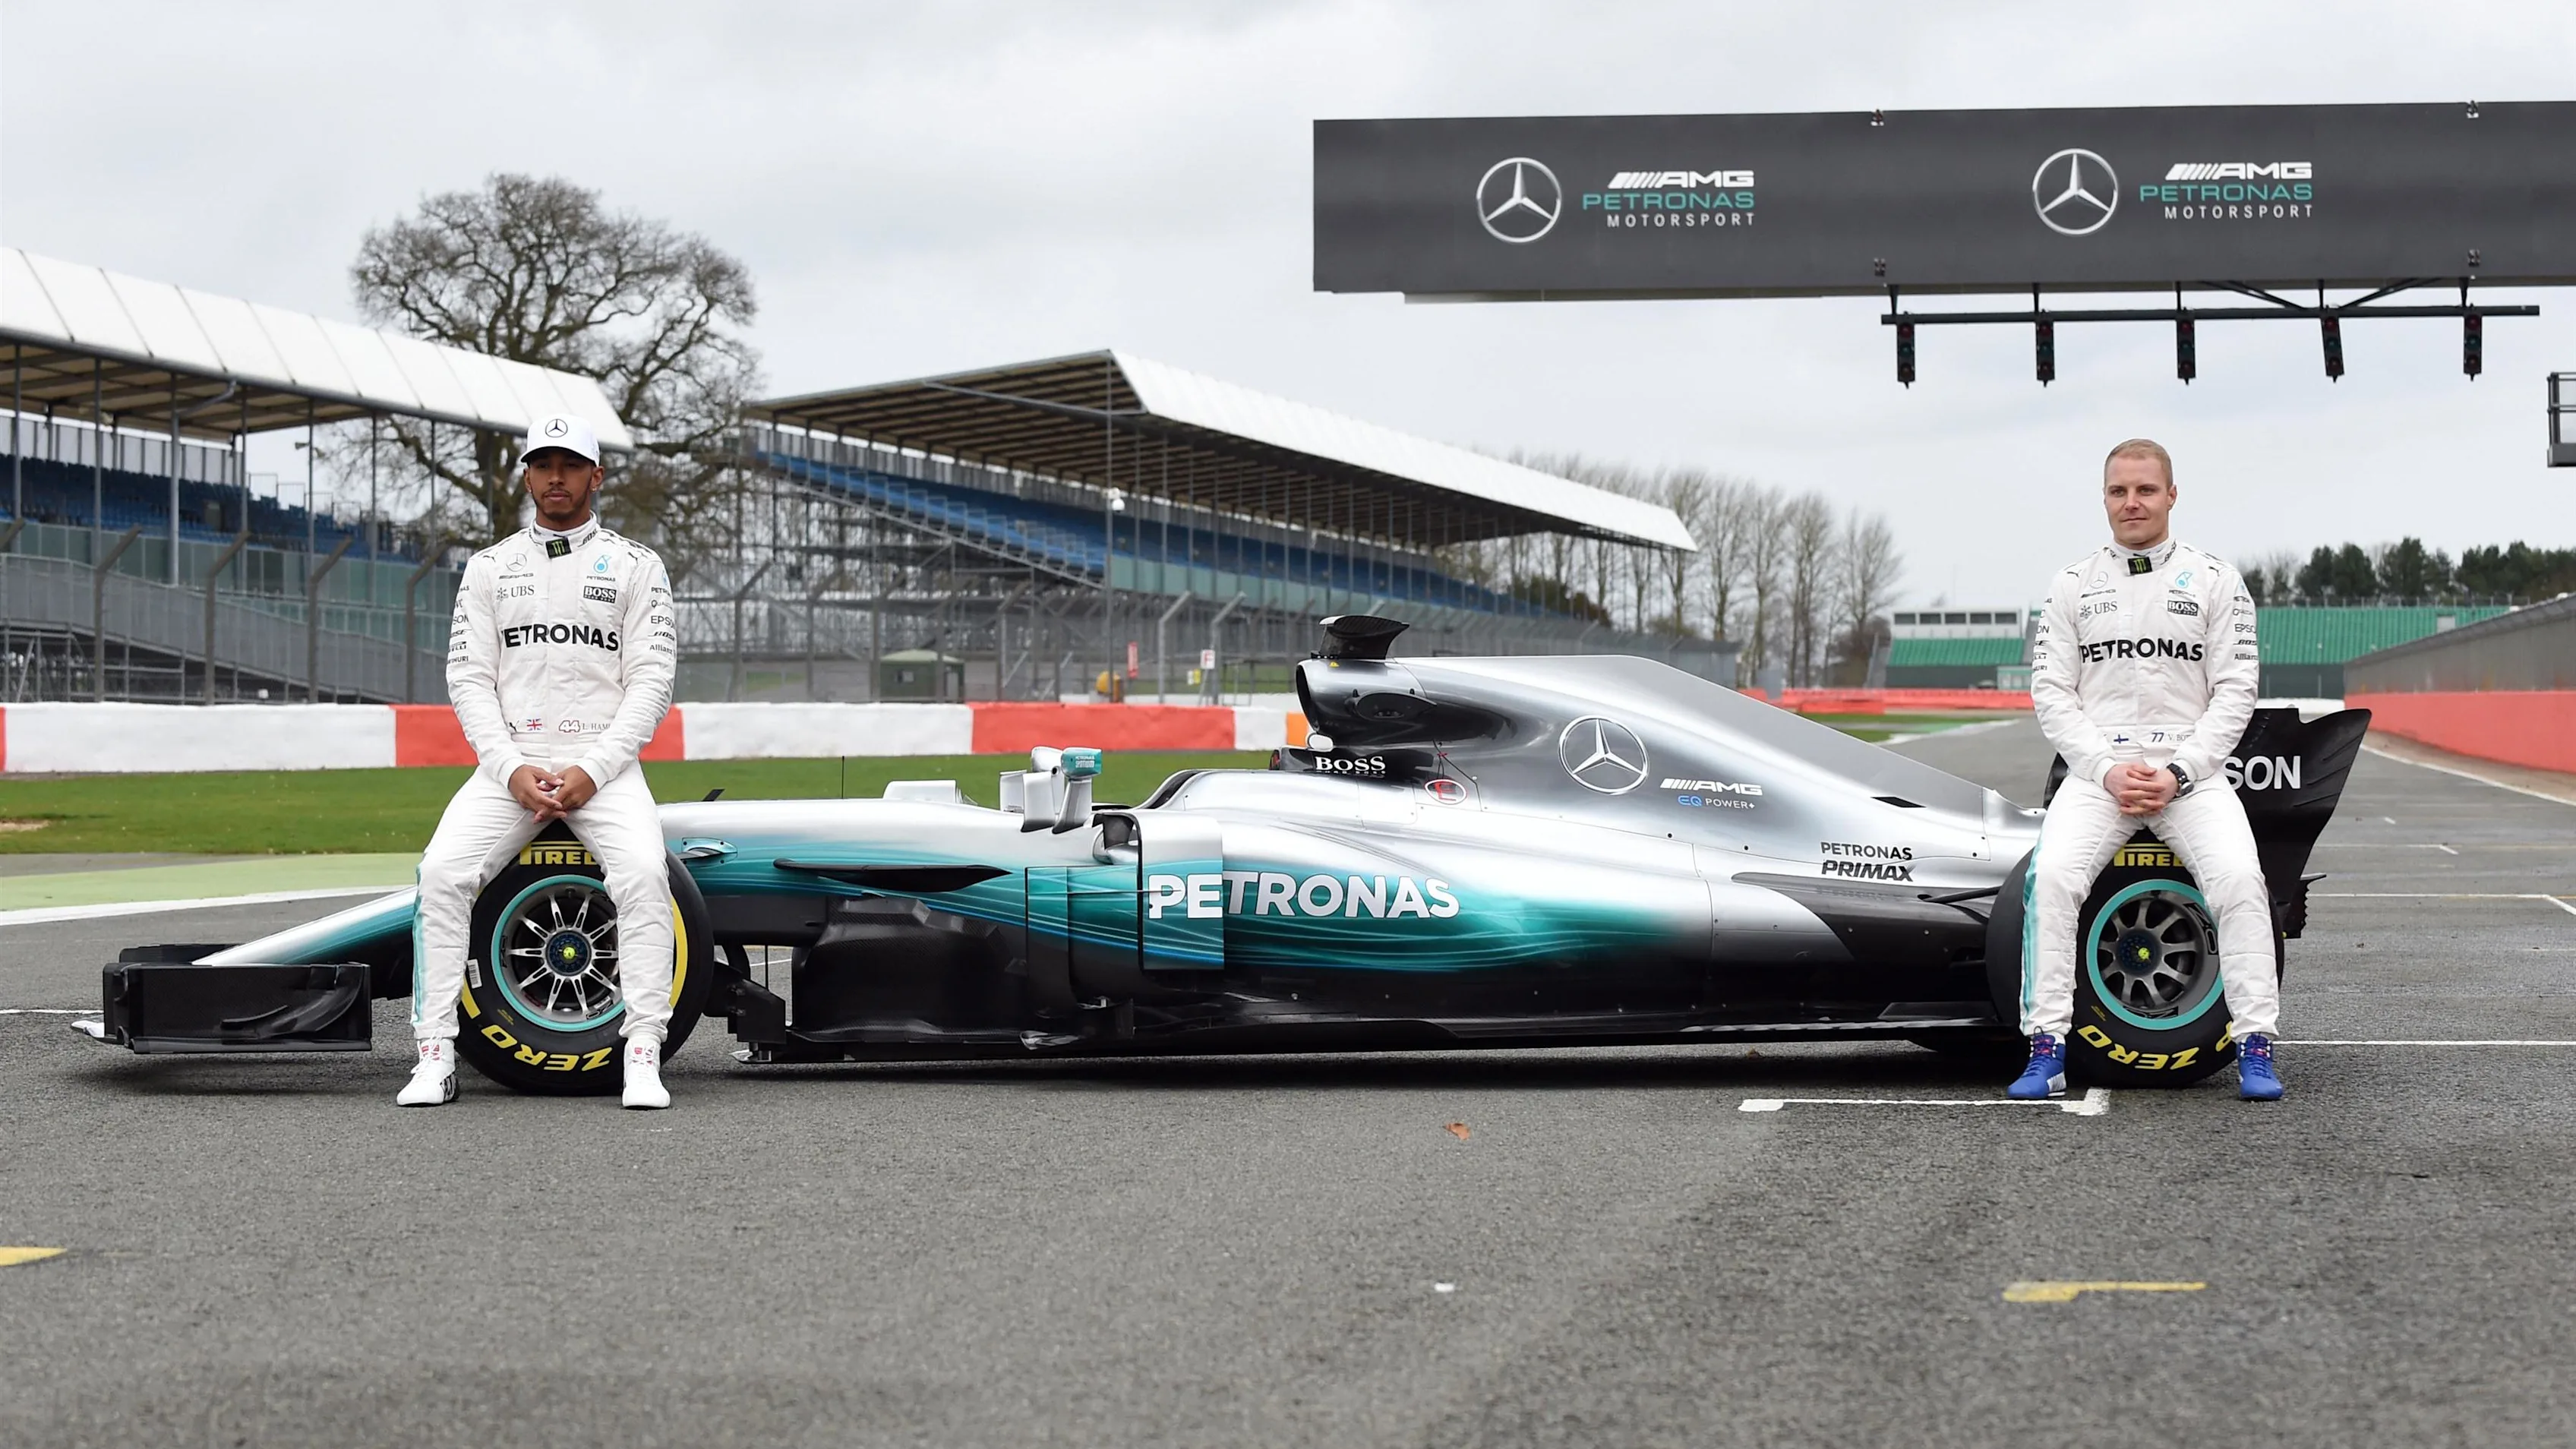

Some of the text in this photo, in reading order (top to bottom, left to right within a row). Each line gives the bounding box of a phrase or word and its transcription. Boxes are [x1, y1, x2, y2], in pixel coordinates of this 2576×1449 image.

[1656, 169, 1755, 188] AMG
[2215, 161, 2312, 180] AMG
[1582, 191, 1755, 210] PETRONAS
[2139, 183, 2312, 202] PETRONAS
[1606, 212, 1756, 228] MOTORSPORT
[2164, 204, 2312, 219] MOTORSPORT
[511, 584, 535, 598] UBS
[584, 586, 616, 600] BOSS
[2094, 601, 2117, 614] UBS
[2168, 601, 2198, 613] BOSS
[502, 623, 620, 652] ETRONAS
[2079, 637, 2203, 664] PETRONAS
[2151, 731, 2164, 743] 77
[1315, 756, 1386, 772] BOSS
[2224, 755, 2301, 791] SON
[1692, 779, 1763, 796] AMG
[1820, 841, 1913, 860] PETRONAS
[1821, 859, 1915, 882] PRIMAX
[1148, 870, 1460, 919] PETRONAS
[481, 1024, 613, 1072] ZERO
[2077, 1024, 2200, 1070] ZERO
